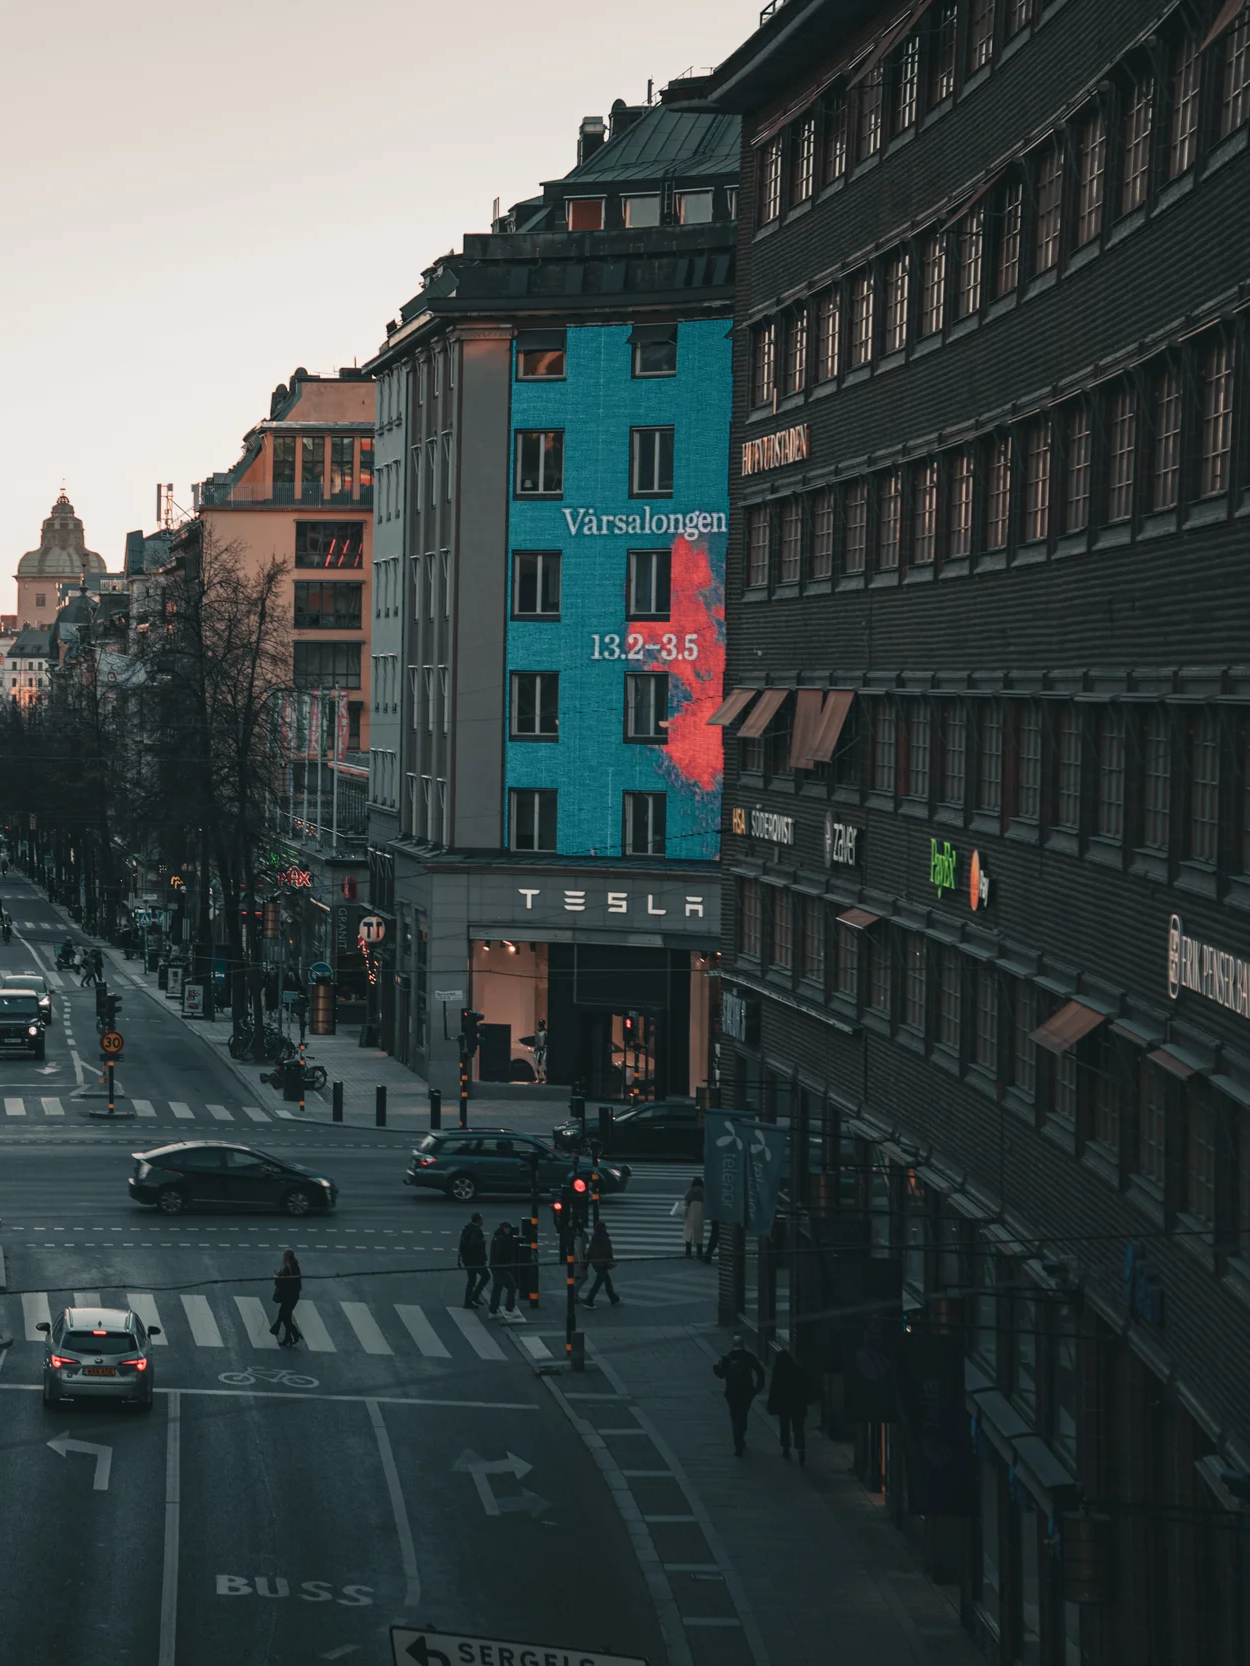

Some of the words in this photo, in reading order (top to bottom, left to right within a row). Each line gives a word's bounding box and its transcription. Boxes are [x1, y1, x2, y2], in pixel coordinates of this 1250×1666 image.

[562, 506, 727, 541] Vårsalongen
[518, 889, 704, 917] TESLA
[338, 908, 347, 949] GRANIT
[1181, 935, 1201, 993] ERIK
[1202, 944, 1235, 1010] PENSER
[105, 1037, 120, 1048] 30
[721, 1153, 738, 1210] telenor
[215, 1574, 375, 1606] BUSS
